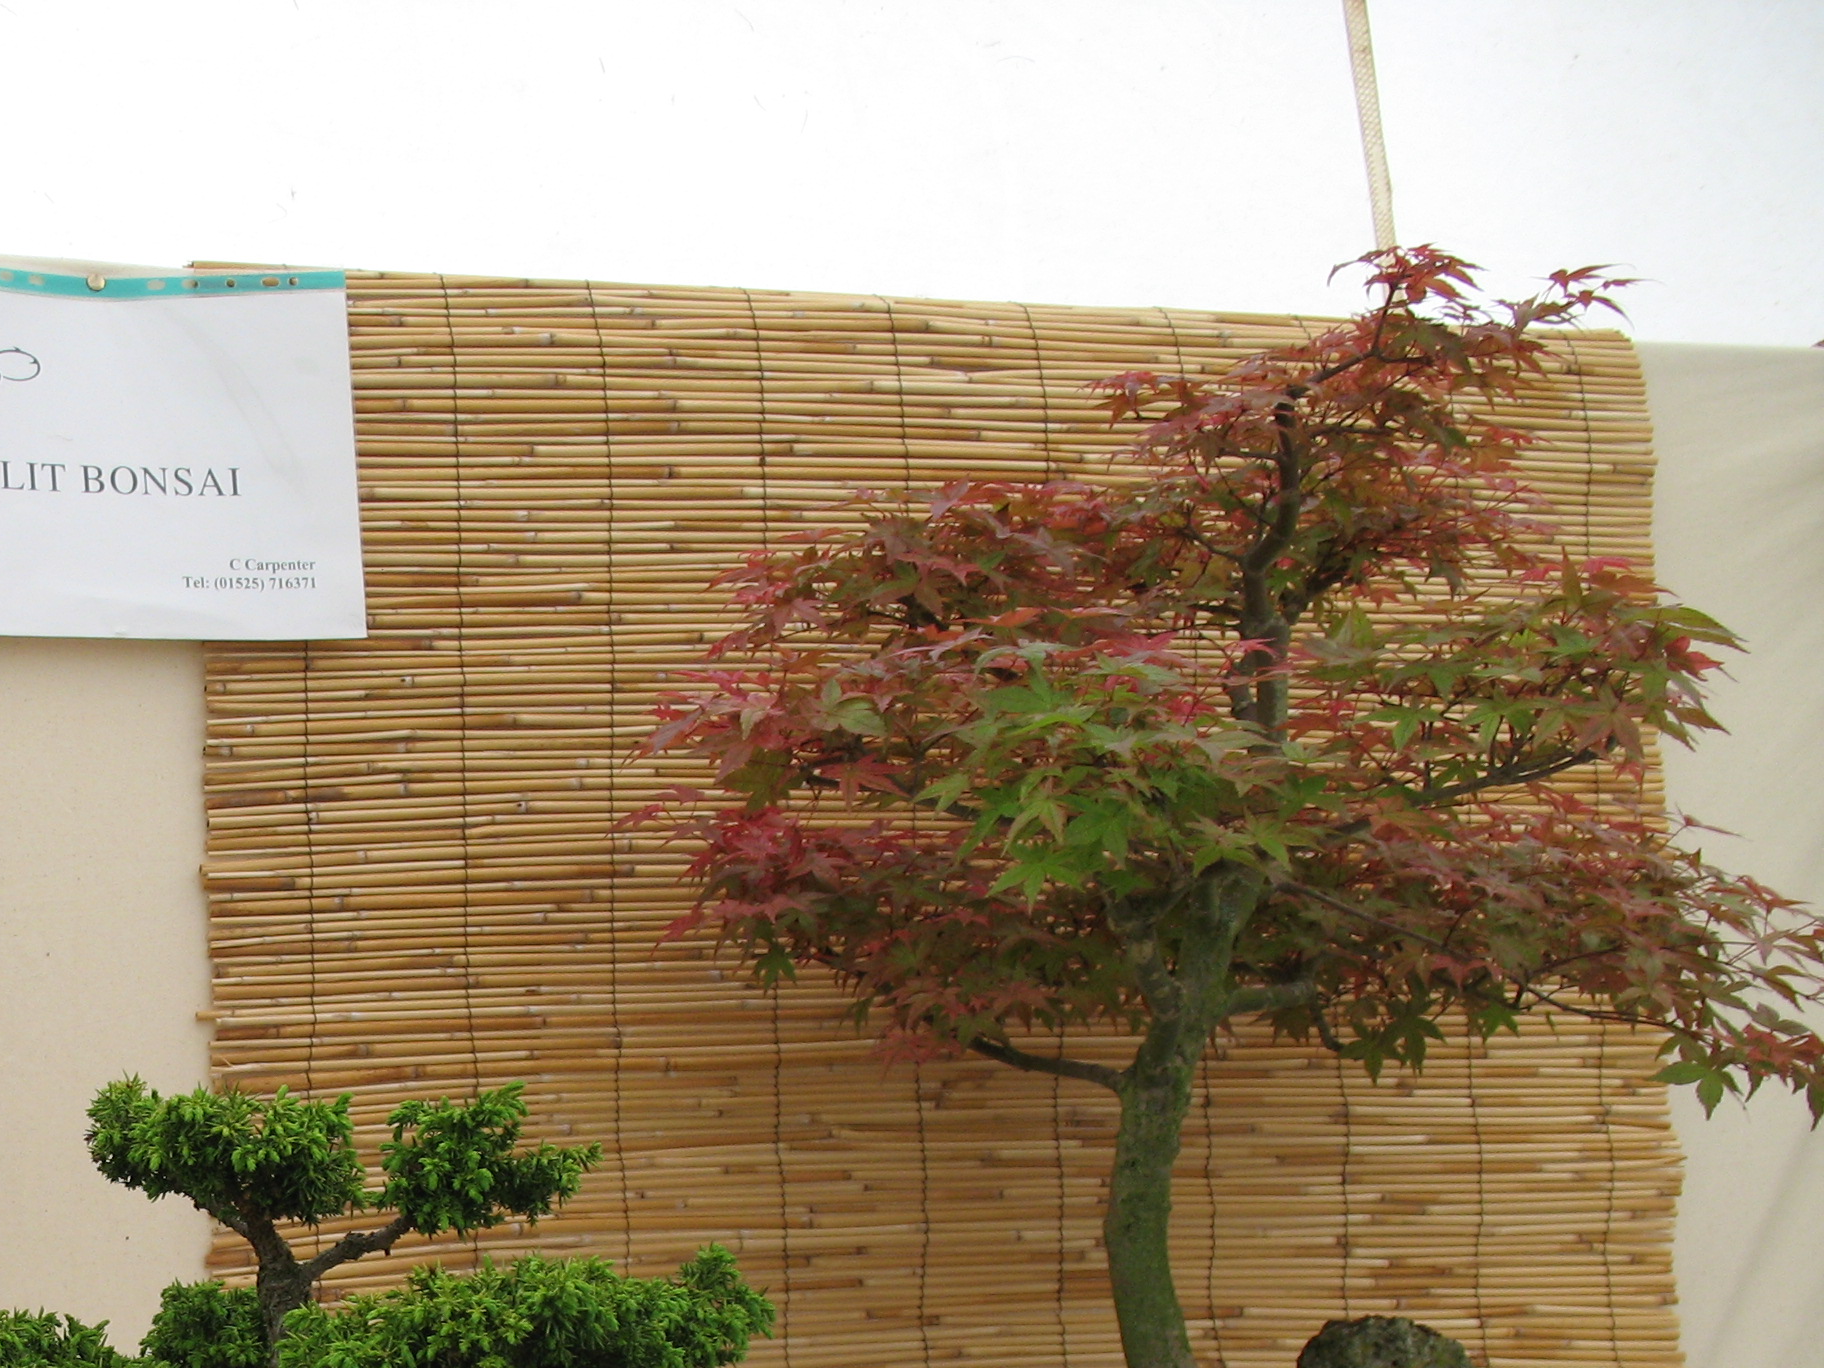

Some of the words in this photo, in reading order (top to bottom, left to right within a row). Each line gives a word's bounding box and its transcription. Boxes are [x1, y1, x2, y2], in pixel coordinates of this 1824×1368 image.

[81, 464, 244, 498] BONSAI
[229, 558, 241, 571] C
[244, 558, 317, 574] Carpenter
[182, 576, 210, 589] Tel:
[214, 576, 265, 592] (01525)
[269, 577, 317, 590] 716371
